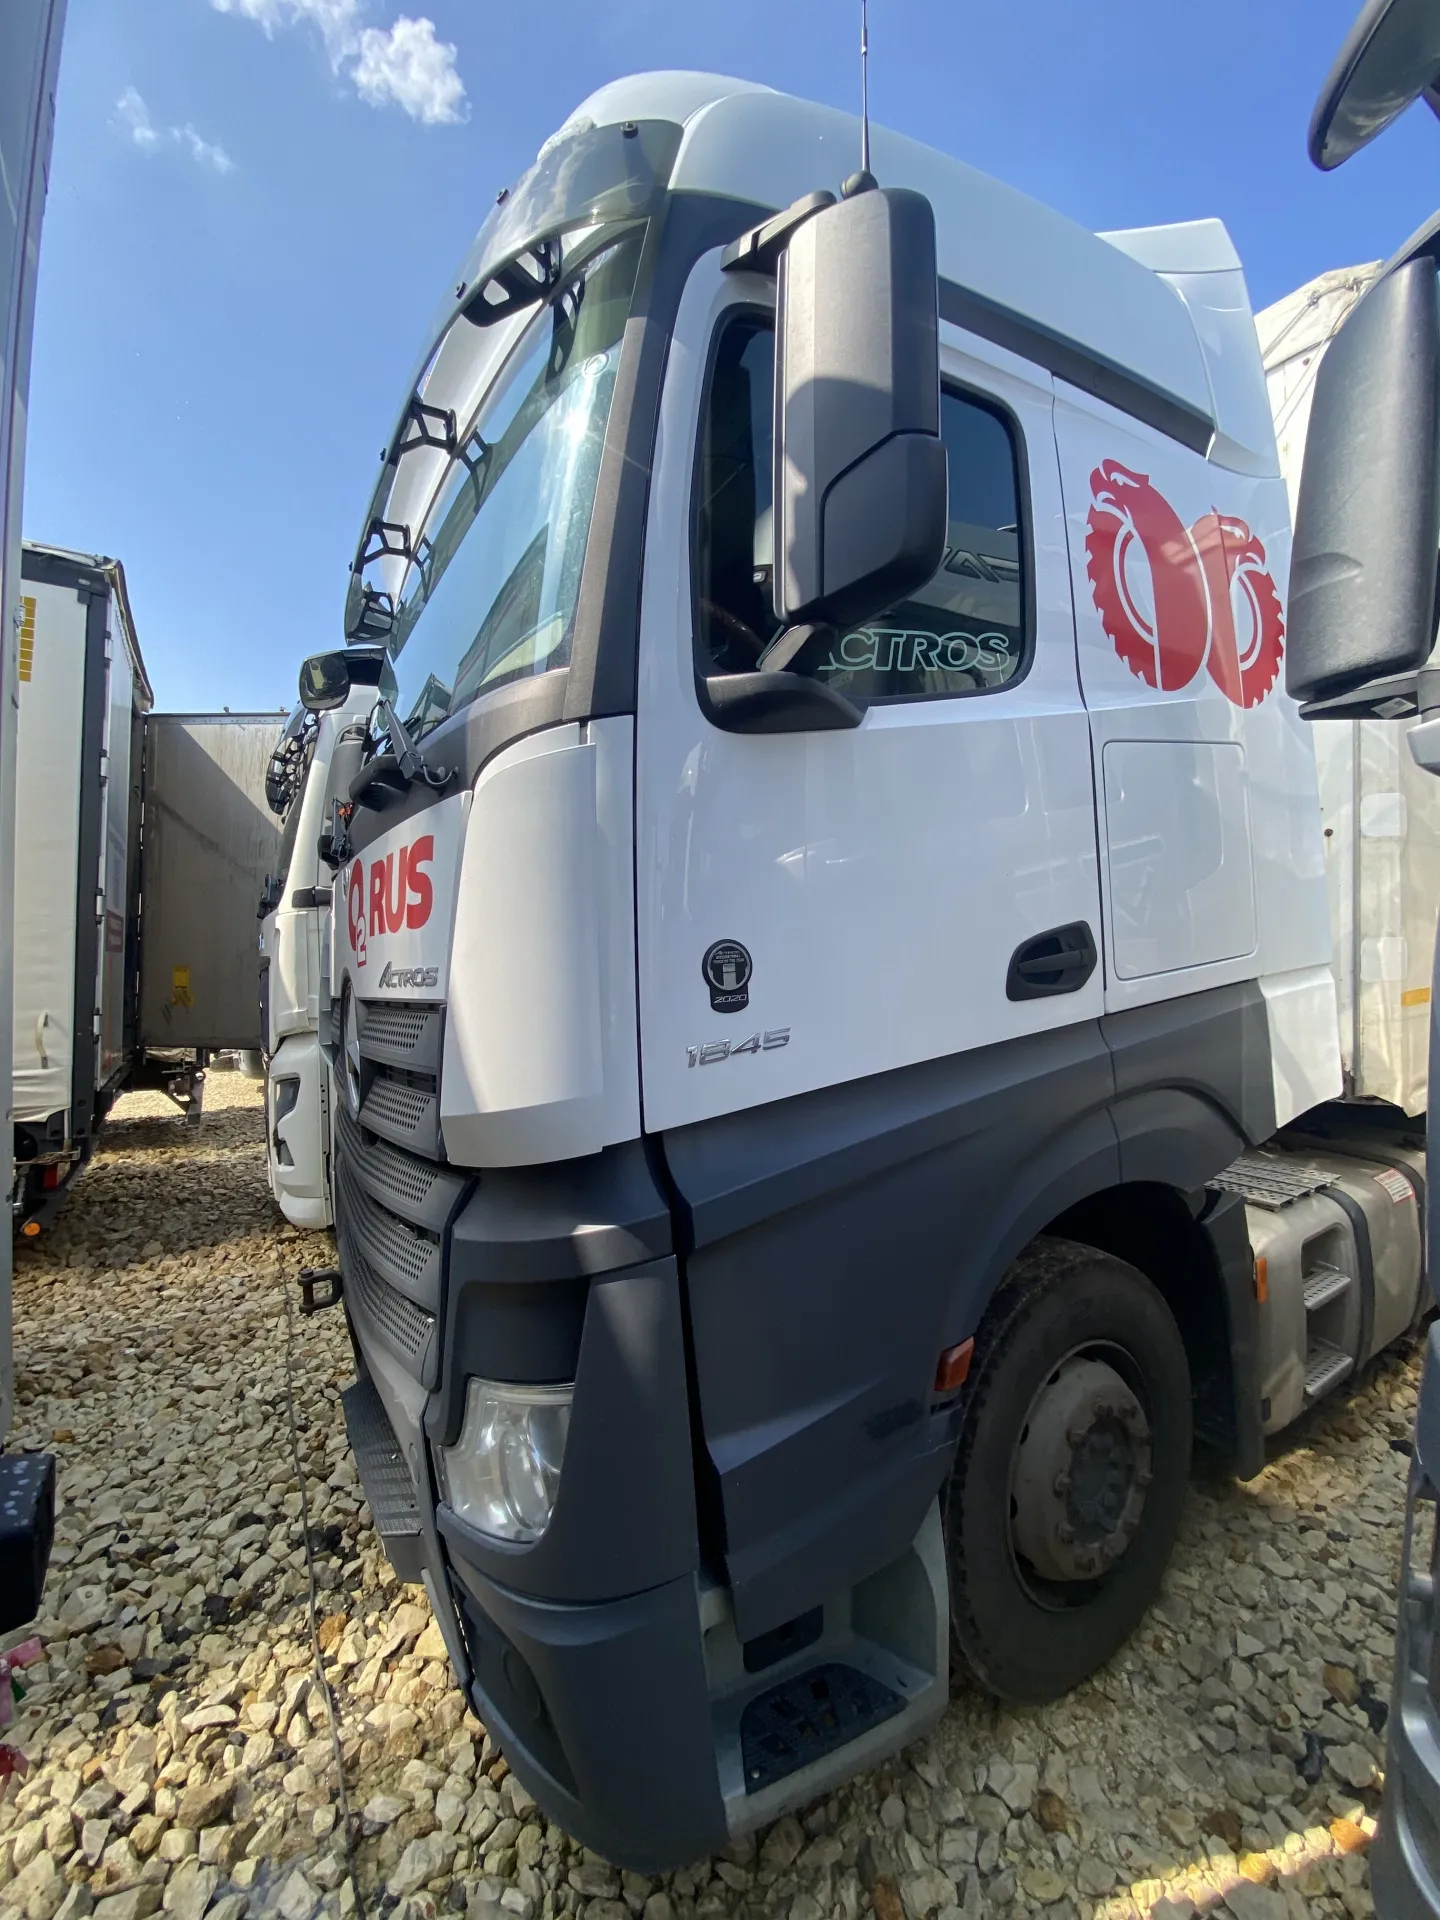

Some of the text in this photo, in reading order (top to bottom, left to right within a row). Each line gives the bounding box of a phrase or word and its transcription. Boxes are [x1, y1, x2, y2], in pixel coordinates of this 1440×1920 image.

[756, 628, 1010, 671] CTROS
[713, 993, 748, 1004] 2020
[686, 1027, 791, 1068] 1845
